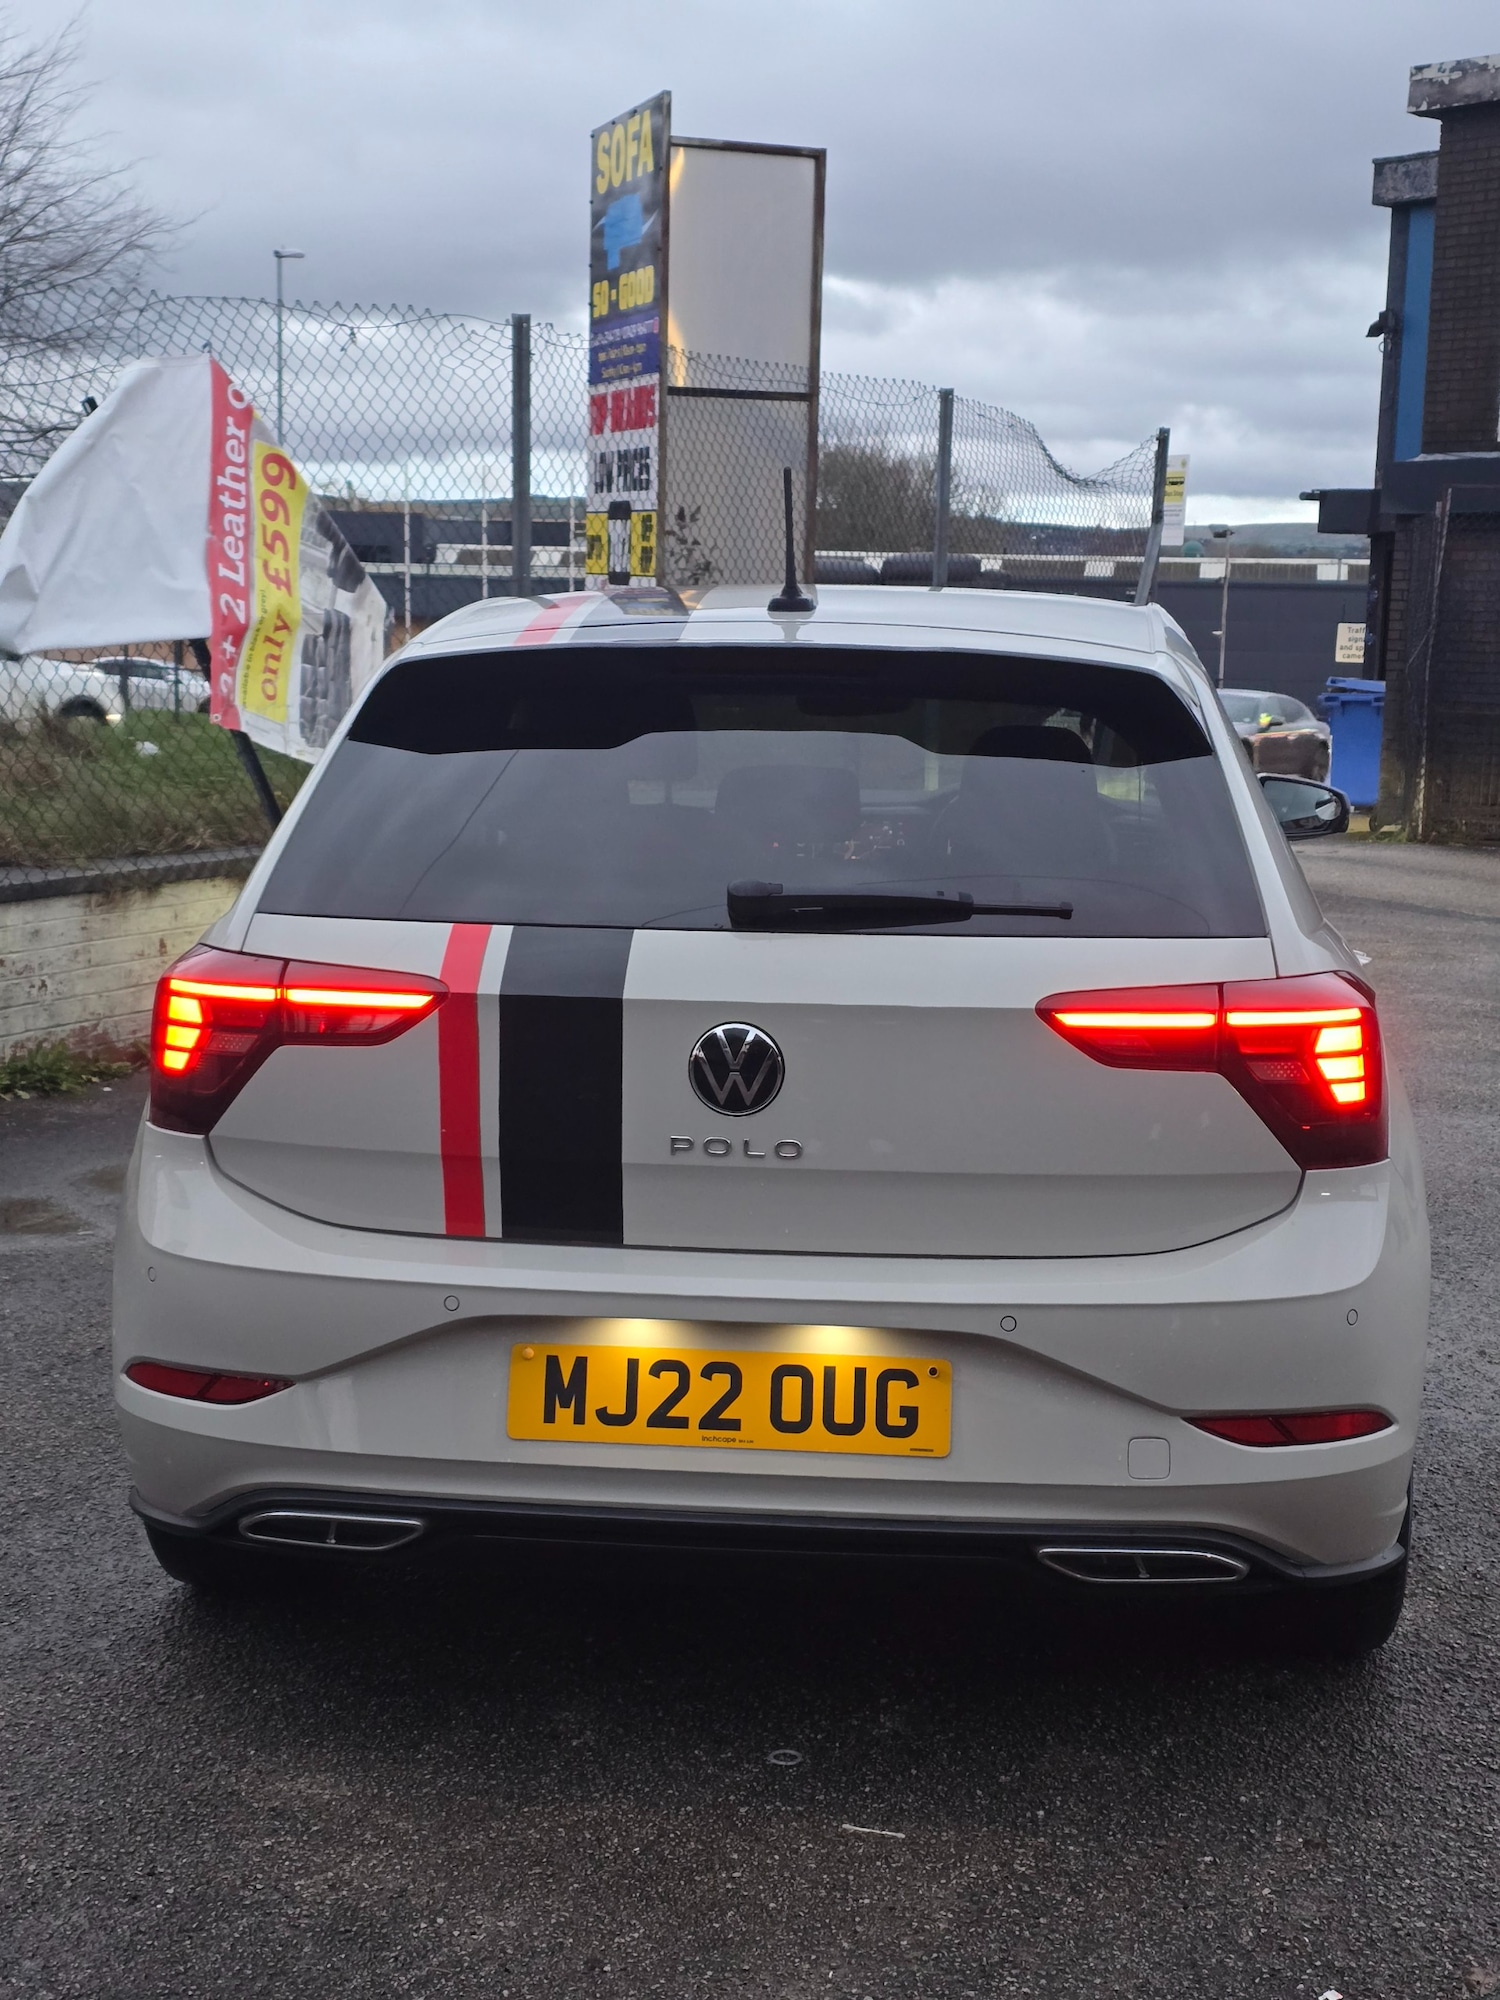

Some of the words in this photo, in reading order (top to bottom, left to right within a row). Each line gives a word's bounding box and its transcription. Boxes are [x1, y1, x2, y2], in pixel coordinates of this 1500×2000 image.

[596, 110, 654, 194] SOFA
[593, 280, 609, 318] SO
[619, 265, 654, 310] GOOD
[217, 416, 247, 586] Leather
[260, 453, 296, 598] £599
[219, 593, 245, 624] 2
[1347, 626, 1366, 634] Traff
[261, 608, 292, 701] only
[670, 1135, 803, 1159] POLO
[543, 1354, 742, 1432] MJ22
[769, 1363, 920, 1439] OUG
